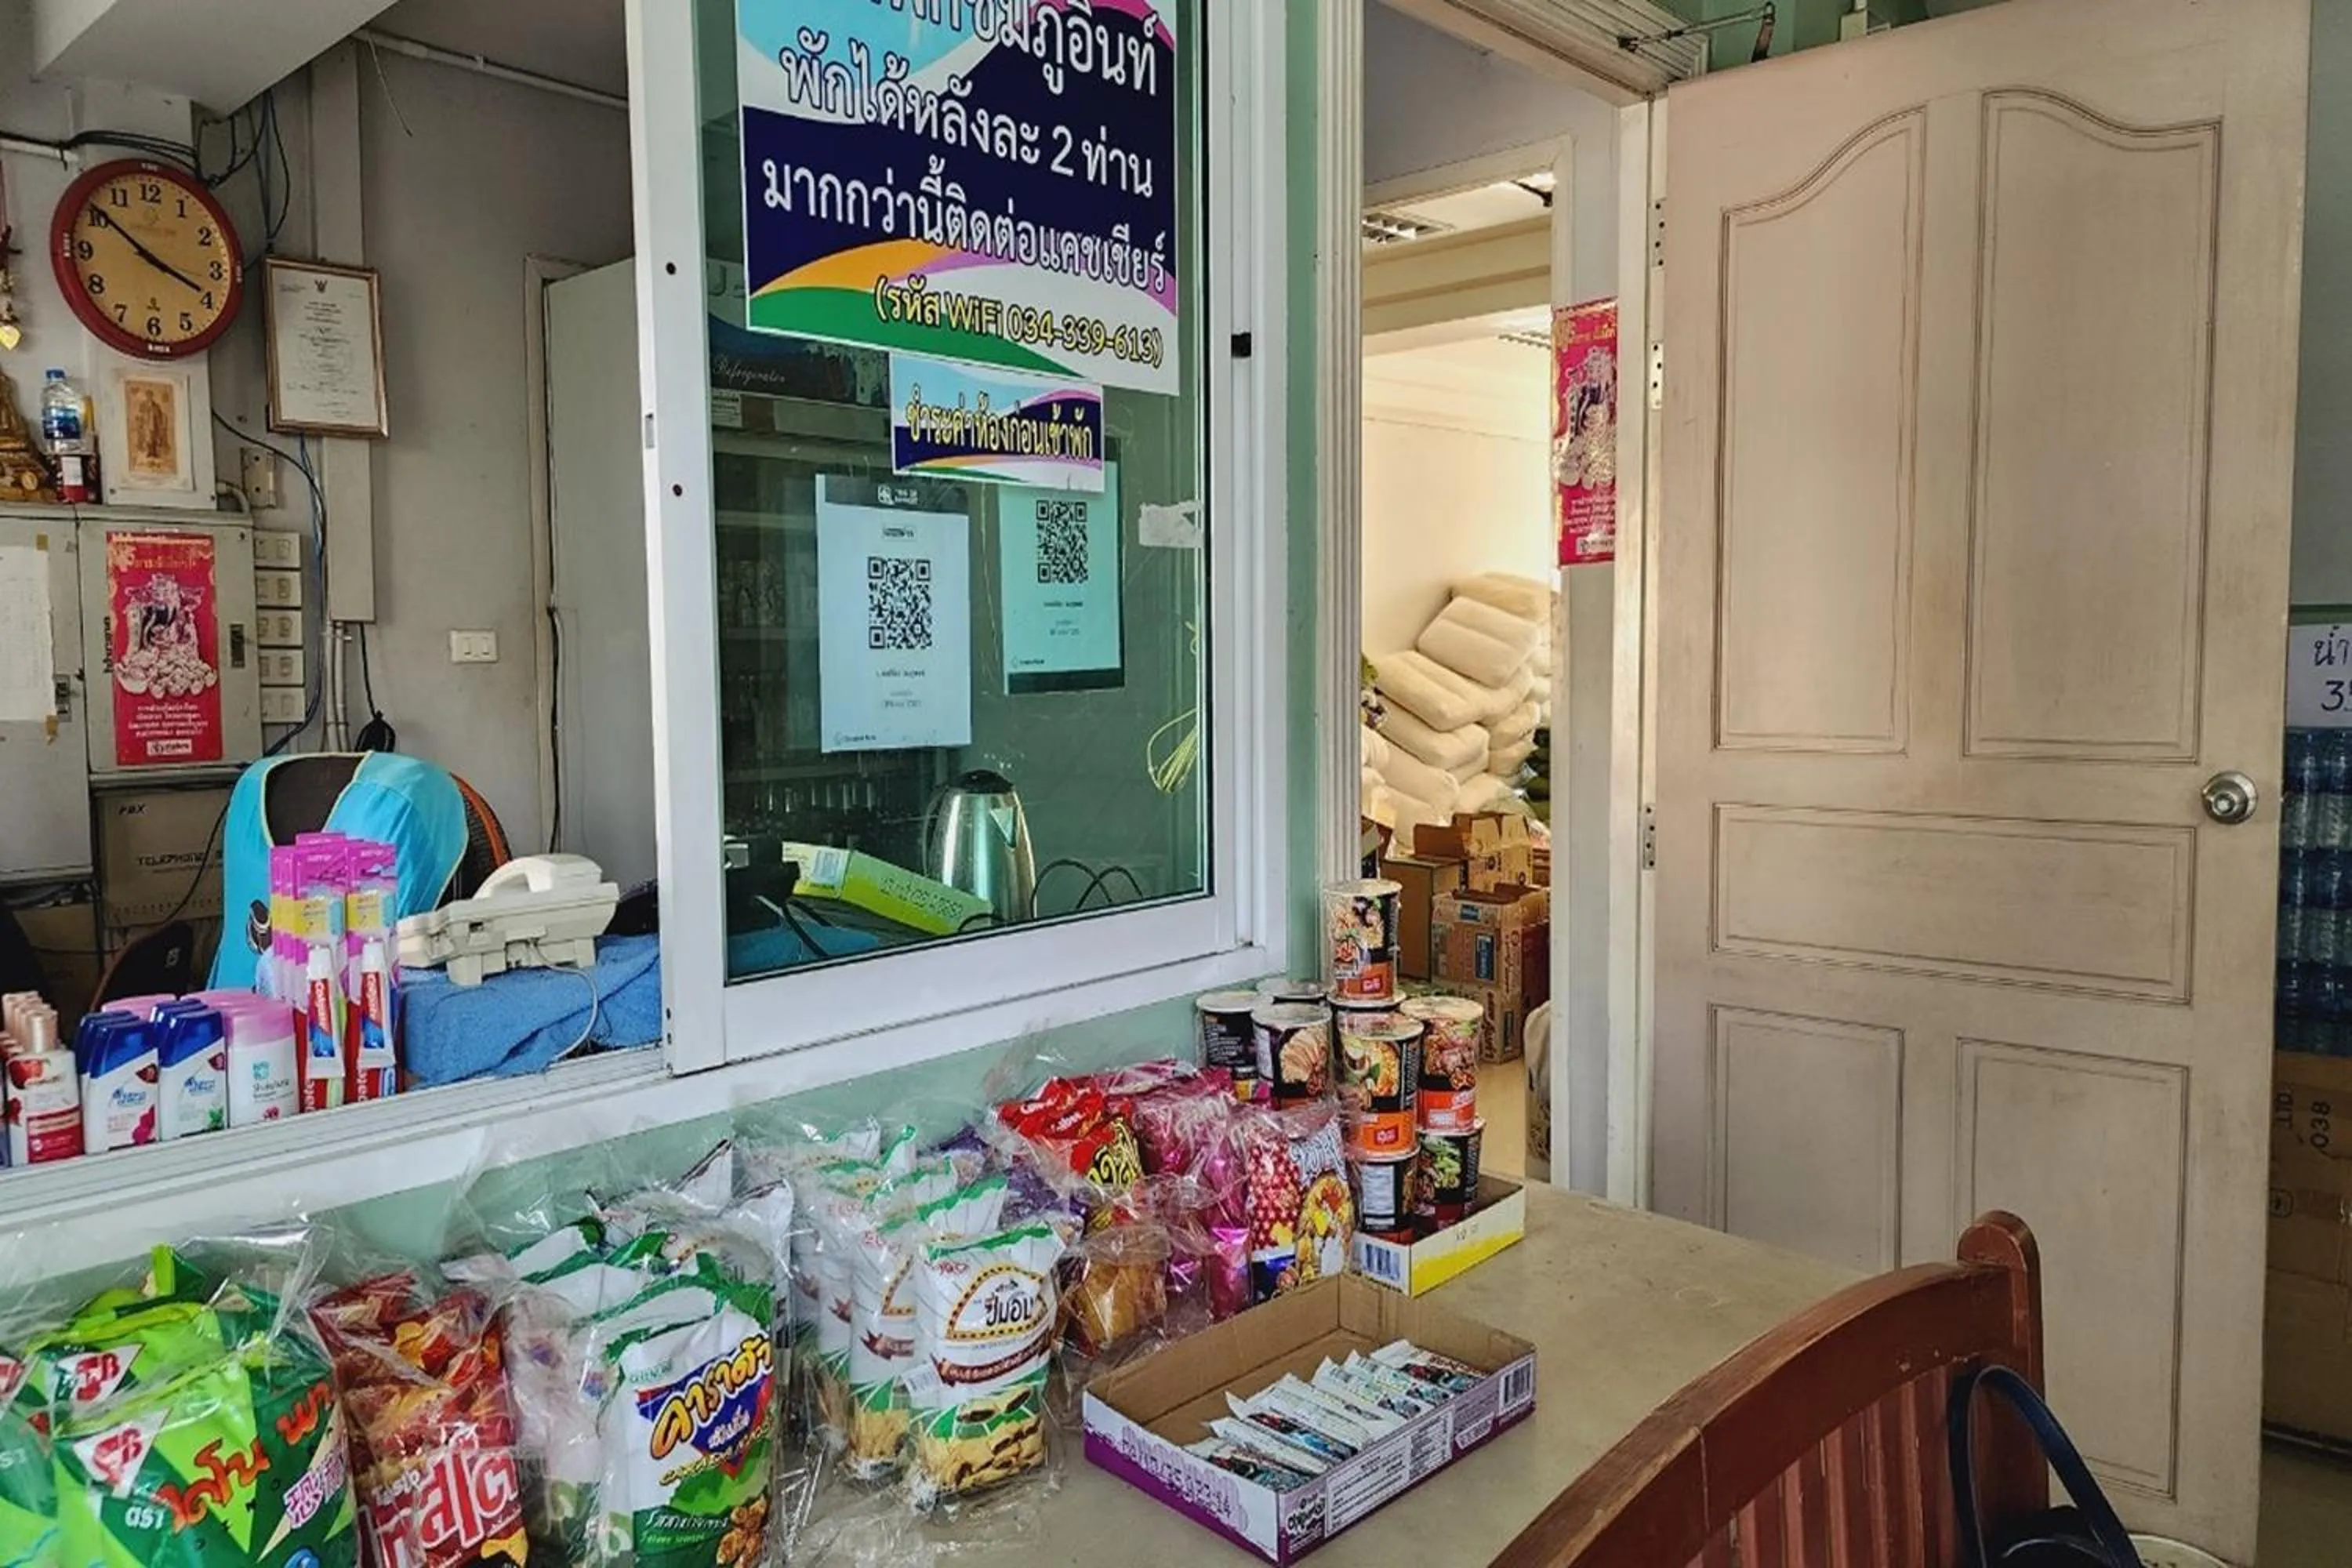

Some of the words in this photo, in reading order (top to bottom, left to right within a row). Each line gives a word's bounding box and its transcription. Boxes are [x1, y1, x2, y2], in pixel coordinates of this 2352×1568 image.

[780, 27, 1041, 166] พักได้หลังละ
[1051, 125, 1075, 177] 2
[1081, 125, 1153, 199] ท่าน
[111, 187, 129, 208] 11
[140, 183, 162, 204] 12
[176, 199, 187, 219] 1
[198, 227, 212, 246] 2
[79, 240, 94, 261] 9
[209, 262, 223, 281] 3
[89, 274, 105, 295] 8
[200, 292, 214, 310] 4
[113, 304, 128, 323] 7
[179, 313, 193, 332] 5
[874, 276, 942, 328] (รหัส
[944, 295, 1007, 339] WiFi
[1007, 306, 1164, 367] 034-339-613)
[147, 317, 162, 337] 6
[2321, 678, 2352, 713] 3
